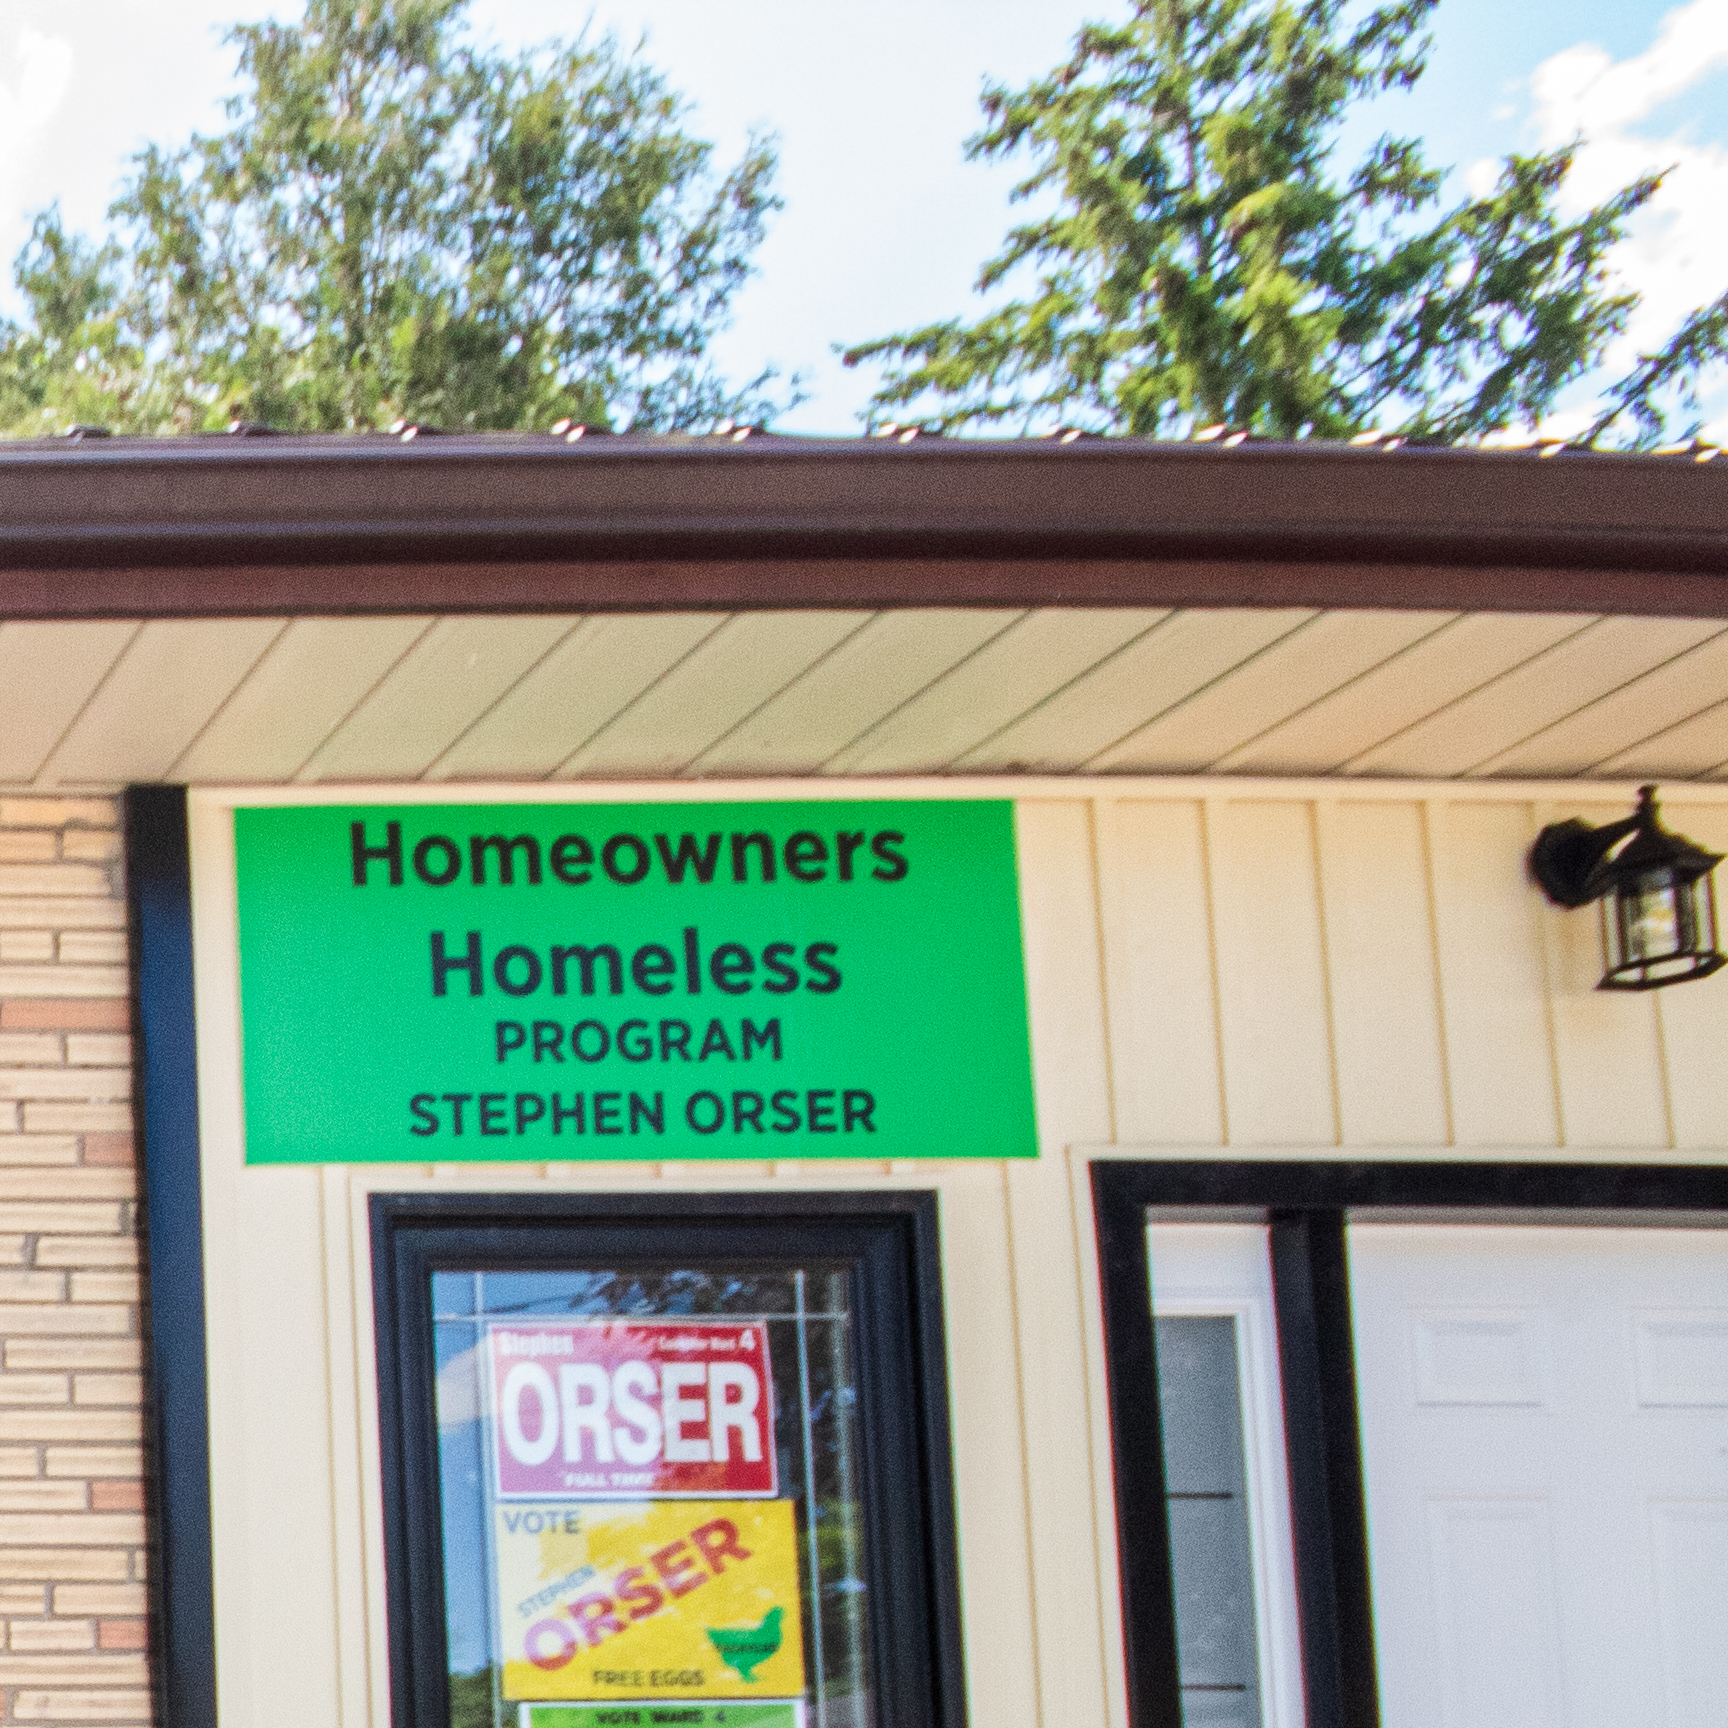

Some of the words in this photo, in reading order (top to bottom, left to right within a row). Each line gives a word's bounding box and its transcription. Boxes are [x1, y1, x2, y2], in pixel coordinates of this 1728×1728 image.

[349, 821, 910, 887] Homeowners
[429, 926, 843, 998] Homeless
[496, 1018, 784, 1064] PROGRAM
[409, 1090, 666, 1137] STEPHEN
[685, 1088, 878, 1133] ORSER
[502, 1360, 763, 1466] ORSER
[503, 1511, 580, 1535] VOTE
[524, 1518, 754, 1672] ORSER
